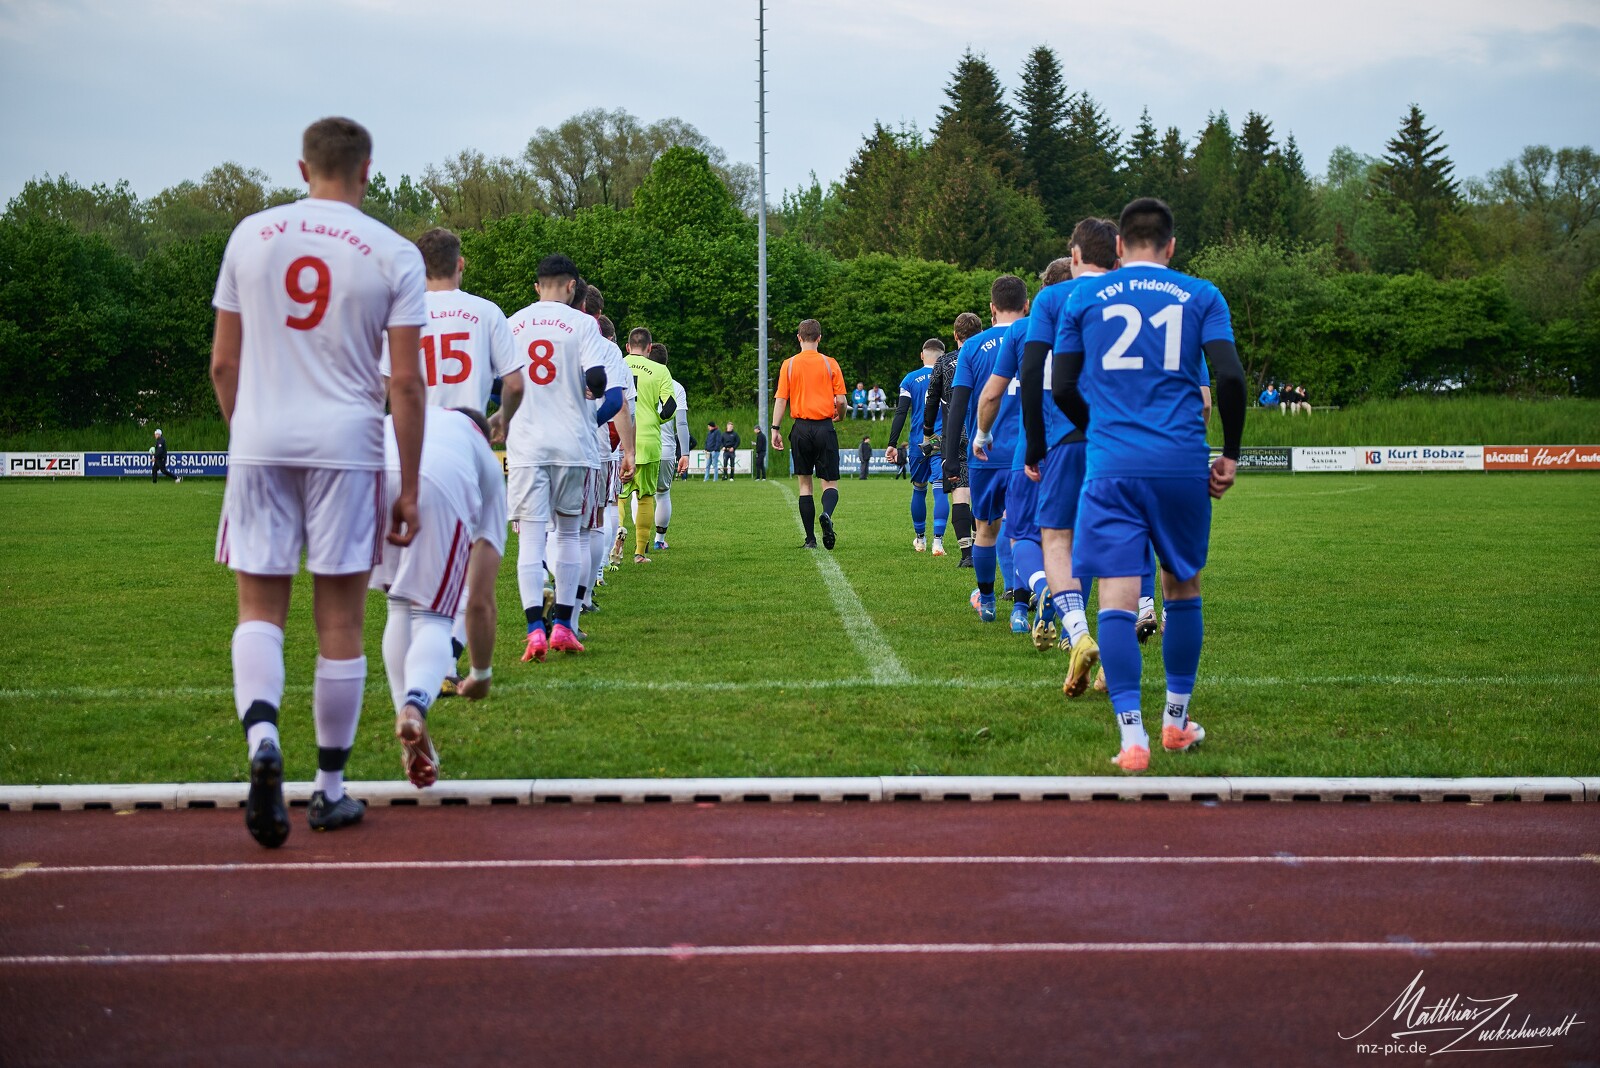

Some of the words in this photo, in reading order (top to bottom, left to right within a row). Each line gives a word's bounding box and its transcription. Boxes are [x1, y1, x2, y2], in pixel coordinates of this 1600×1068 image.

[301, 219, 372, 256] Laufen
[285, 255, 332, 331] 9
[1096, 281, 1123, 301] TSV
[1129, 278, 1191, 303] Fridolfing
[430, 308, 479, 325] Laufen
[512, 320, 526, 336] SV
[532, 317, 574, 334] Laufen
[980, 338, 997, 353] TSV
[1102, 303, 1184, 371] 21
[419, 331, 472, 387] 15
[527, 339, 557, 385] 8
[628, 364, 654, 376] aufen
[914, 374, 926, 383] TSV
[1388, 448, 1418, 459] Kurt
[1423, 448, 1465, 459] Bobaz
[1532, 448, 1576, 466] Hartl
[1576, 453, 1600, 463] Laufe
